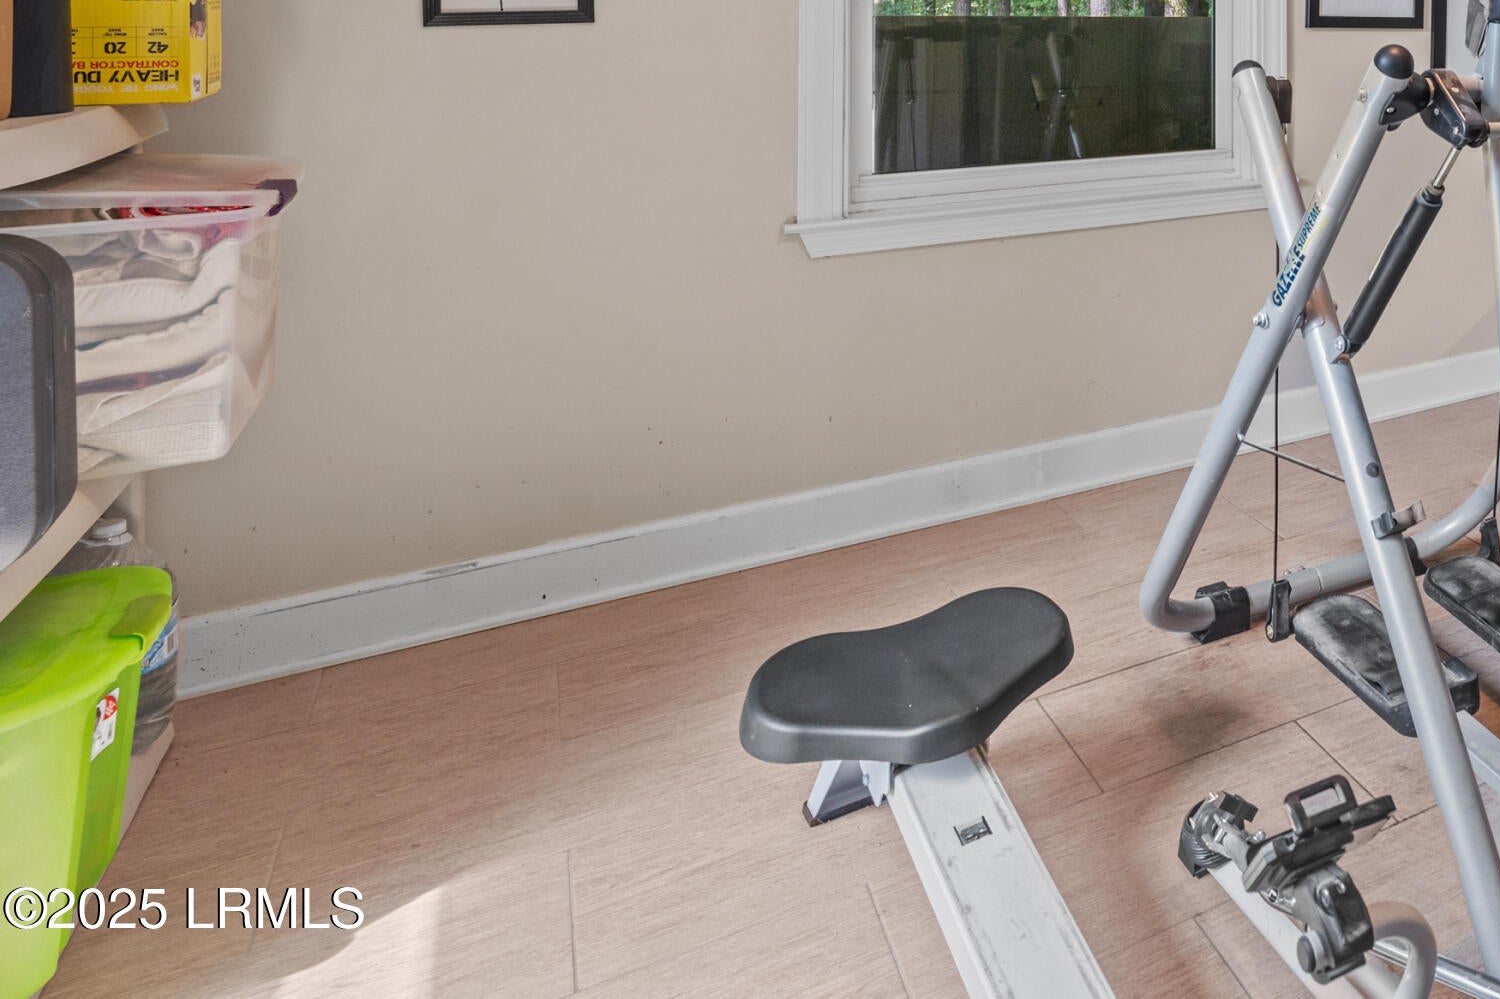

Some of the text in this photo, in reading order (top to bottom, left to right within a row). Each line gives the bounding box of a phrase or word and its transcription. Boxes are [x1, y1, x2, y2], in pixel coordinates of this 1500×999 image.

[103, 41, 127, 54] 20
[147, 41, 169, 54] 42
[90, 60, 179, 69] CONTRACTOR
[73, 70, 179, 84] HEAVY DU
[144, 84, 179, 92] WING
[1297, 202, 1322, 251] SUPREME
